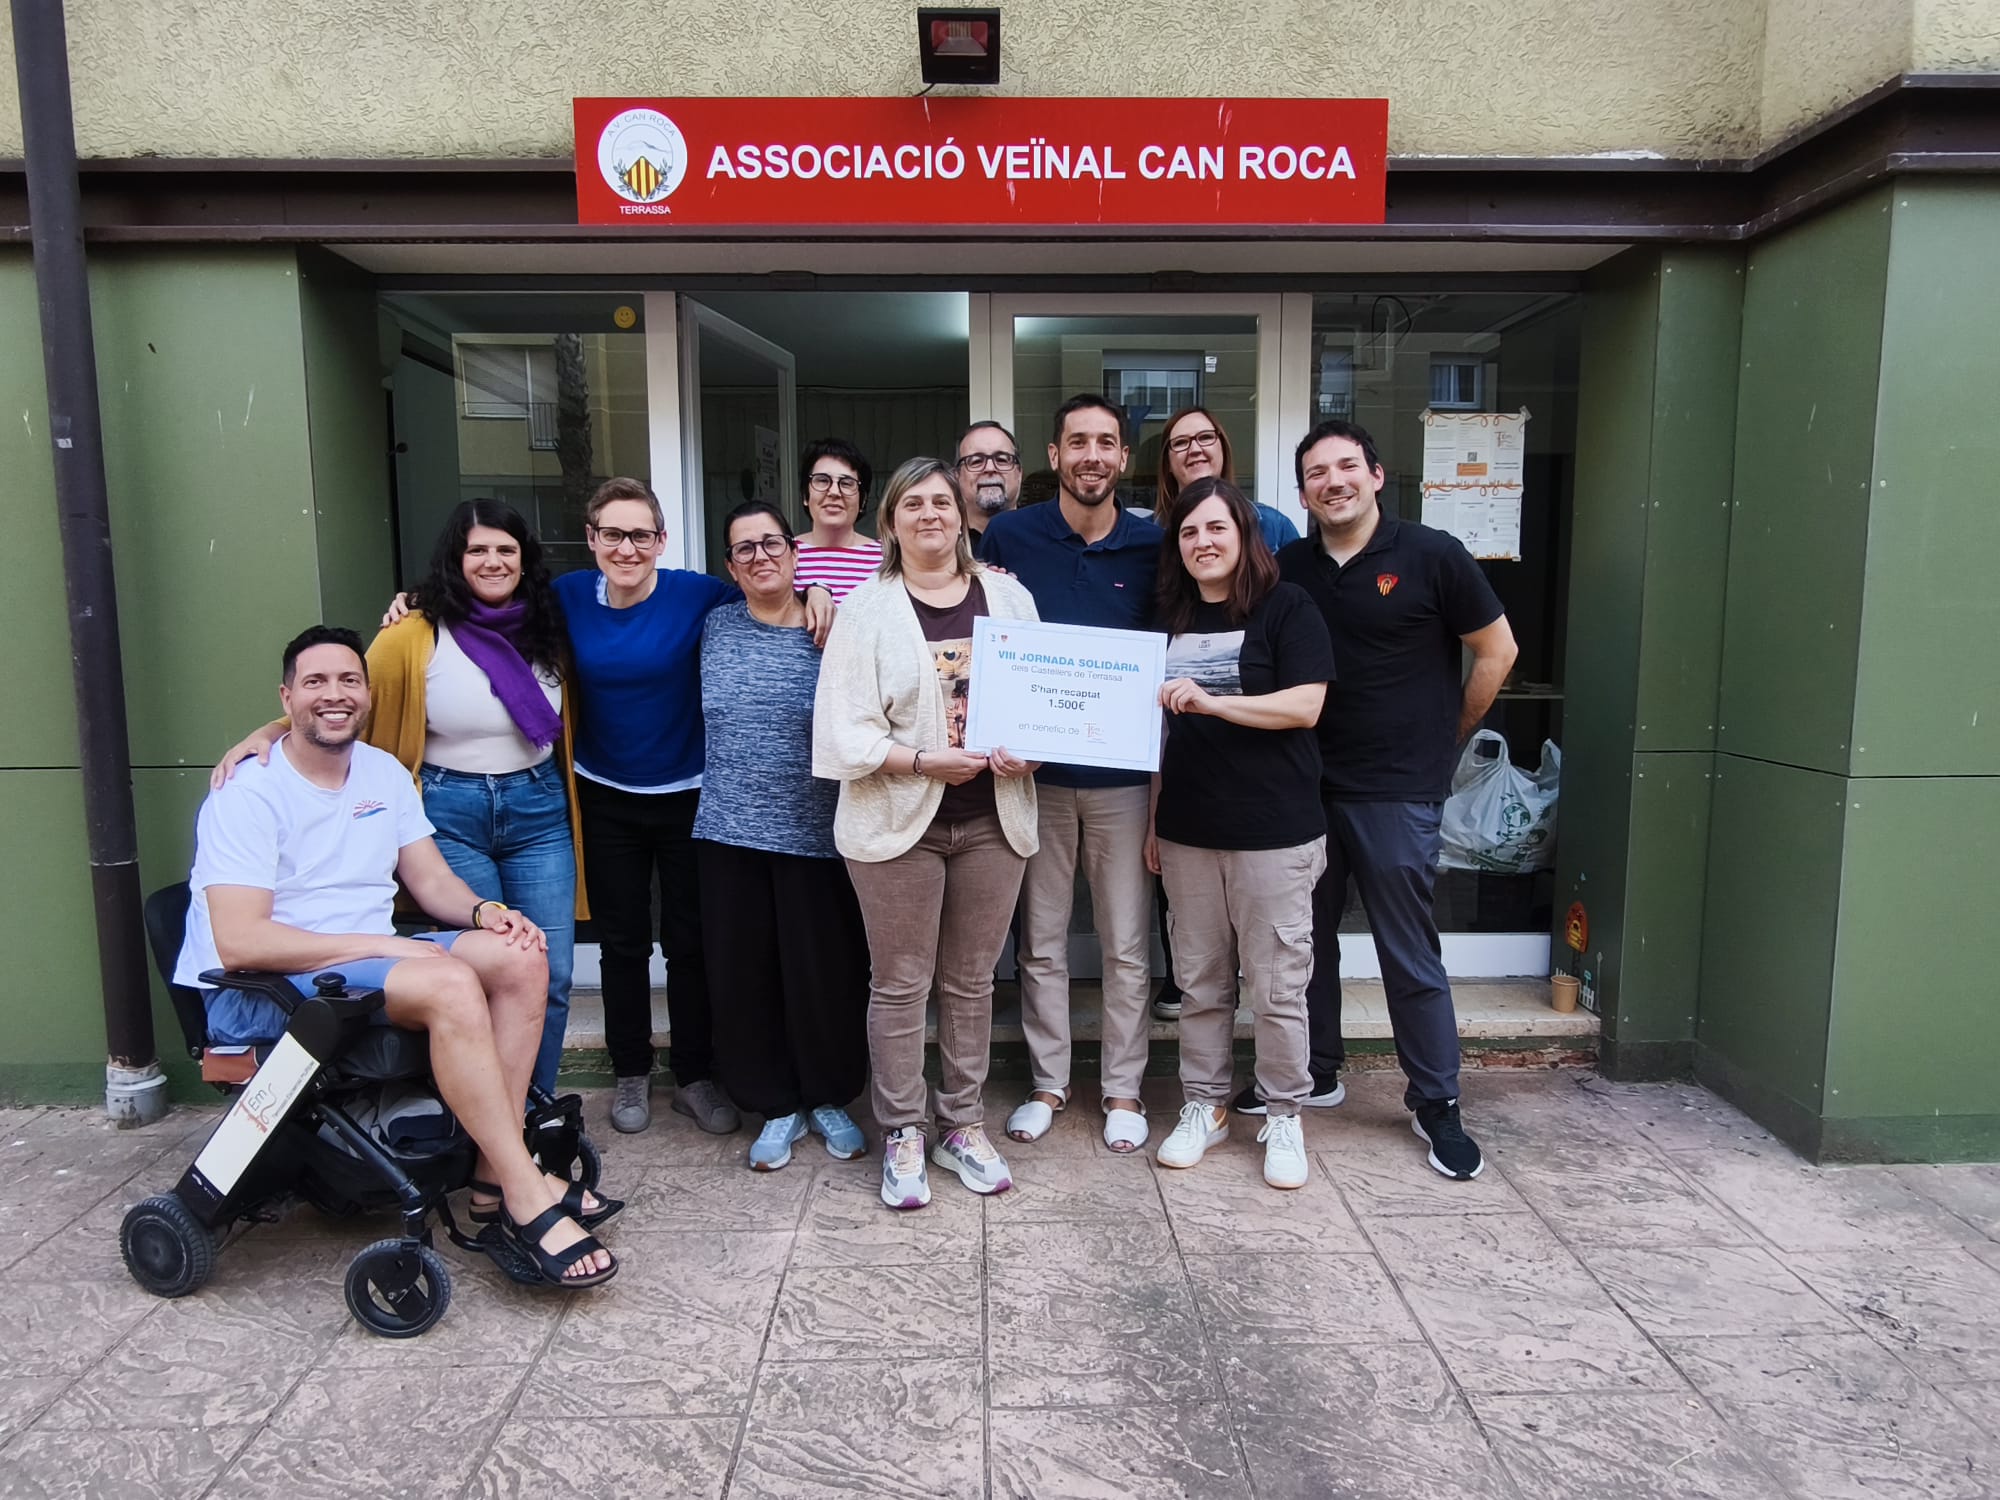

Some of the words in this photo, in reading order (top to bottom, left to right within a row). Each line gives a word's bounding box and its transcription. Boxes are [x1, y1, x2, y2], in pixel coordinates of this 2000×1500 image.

[624, 113, 646, 122] CAN
[649, 114, 675, 137] ROCA
[706, 137, 965, 179] ASSOCIACIÓ
[976, 137, 1126, 179] VEÏNAL
[1138, 145, 1224, 179] CAN
[1239, 145, 1356, 179] ROCA
[619, 205, 671, 215] TERRASSA
[998, 650, 1016, 660] VIII
[1020, 653, 1075, 666] JORNADA
[1078, 658, 1140, 673] SOLIDÀRIA
[1011, 664, 1029, 673] dels
[1031, 665, 1072, 677] Castellers
[1074, 670, 1085, 678] de
[1088, 671, 1123, 682] Terrassa
[1030, 683, 1058, 695] S'han
[1060, 688, 1101, 699] recaptat
[1048, 698, 1087, 711] 1.500€
[1018, 723, 1030, 731] en
[1032, 722, 1066, 734] benefici
[1068, 727, 1080, 736] de
